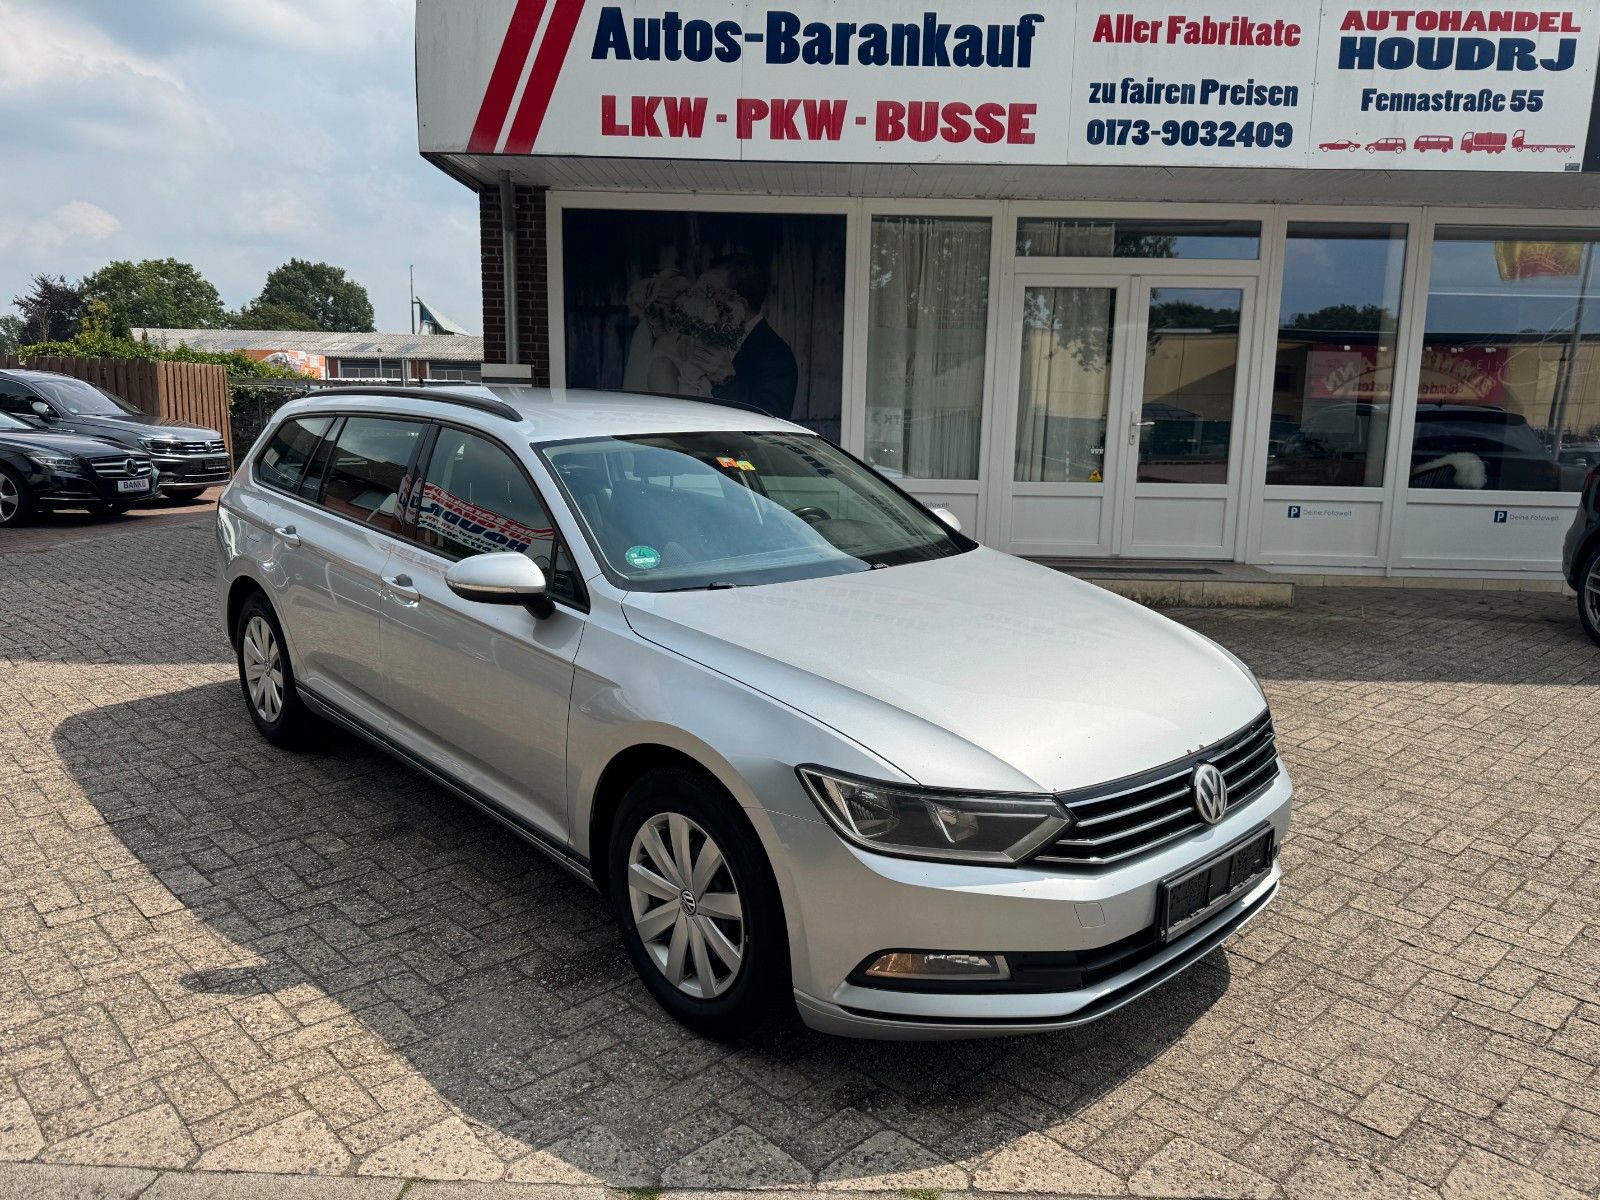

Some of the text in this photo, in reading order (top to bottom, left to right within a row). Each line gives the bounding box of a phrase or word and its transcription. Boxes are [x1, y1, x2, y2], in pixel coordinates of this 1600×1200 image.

[1093, 14, 1301, 47] Aller Fabrikate
[1340, 10, 1581, 32] AUTOHANDEL
[591, 7, 1045, 68] Autos-Barankauf
[1338, 36, 1577, 71] HOUDRJ
[1089, 77, 1299, 107] zu fairen Preisen
[1361, 88, 1544, 112] Fennastraße 55
[602, 95, 708, 138] LKW
[737, 98, 848, 141] PKW
[875, 100, 1038, 144] BUSSE
[1087, 119, 1294, 149] 0173-9032409
